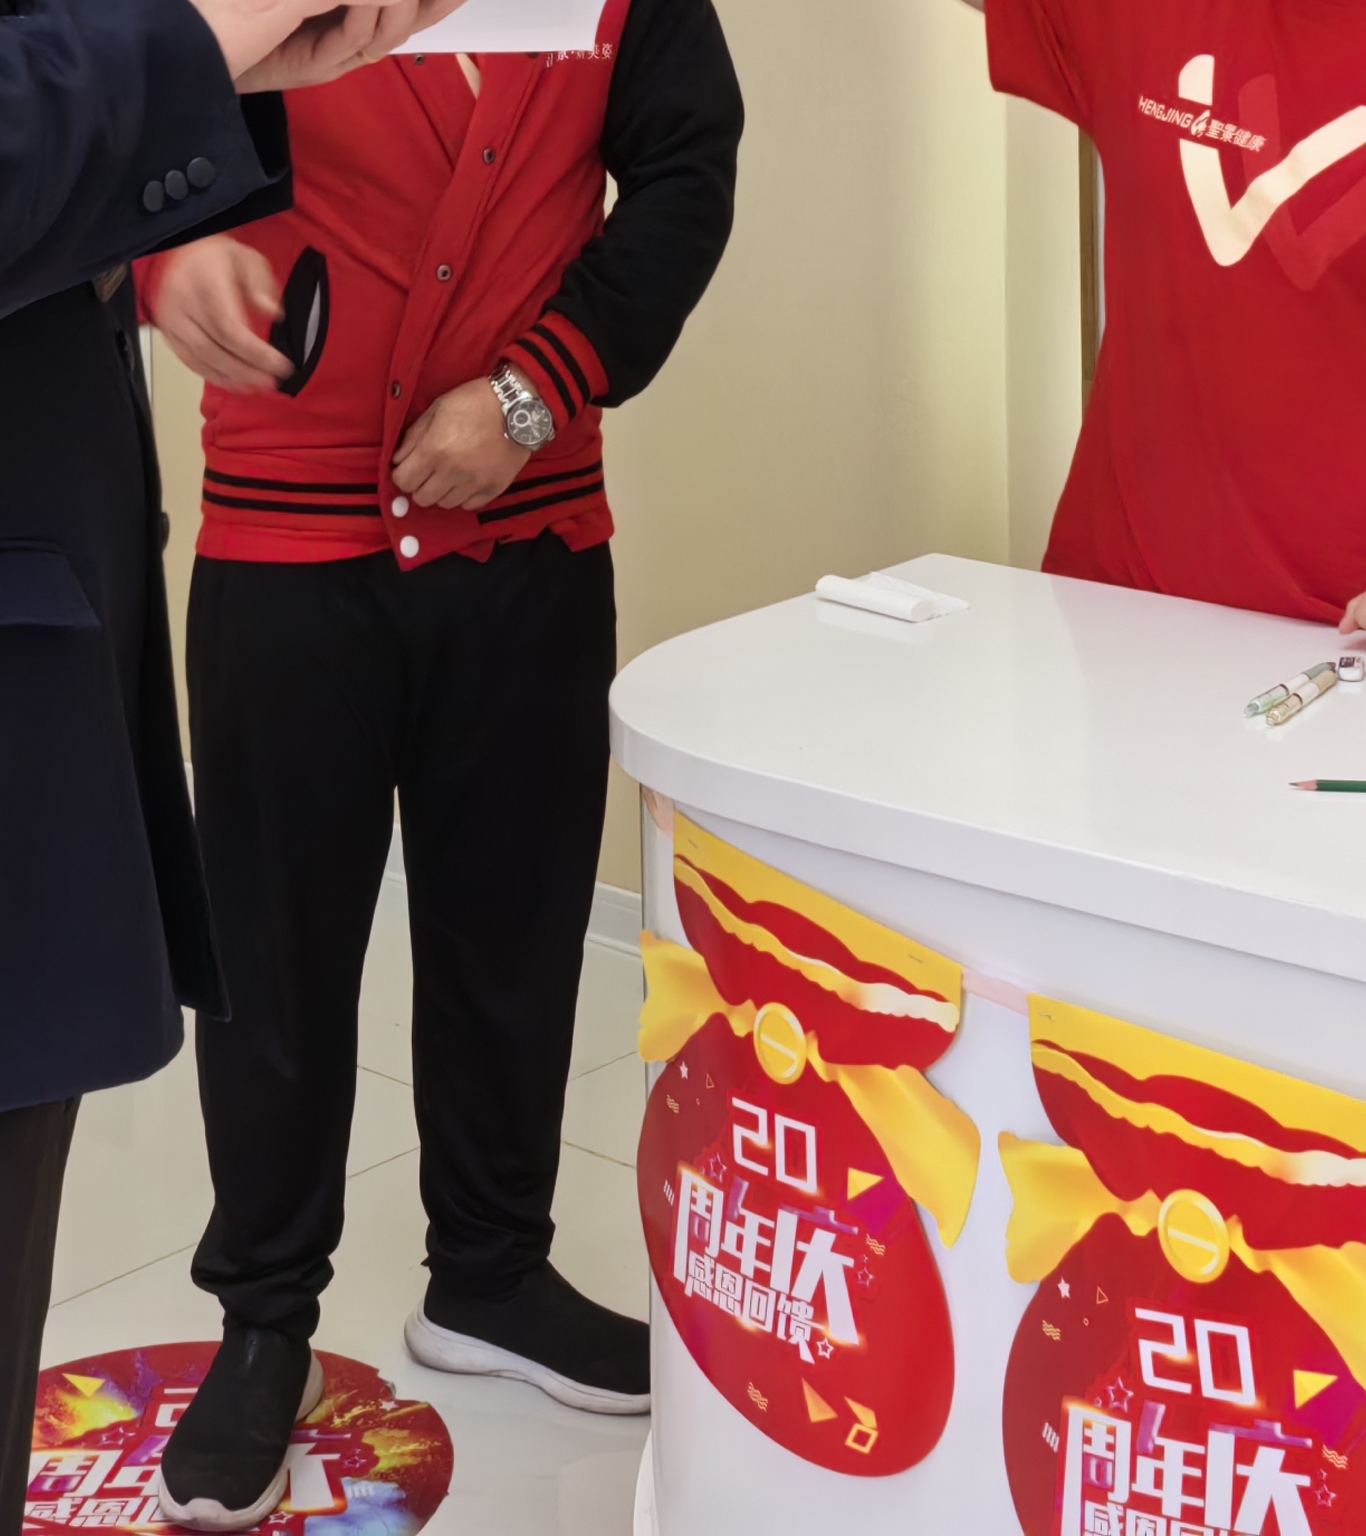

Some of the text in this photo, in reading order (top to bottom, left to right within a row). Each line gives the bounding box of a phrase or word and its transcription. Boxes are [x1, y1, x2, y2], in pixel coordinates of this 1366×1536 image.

[1206, 119, 1267, 153] 聖景健康
[731, 1096, 819, 1193] 20
[674, 1167, 861, 1345] 周年庆
[685, 1250, 826, 1364] 感恩回馈
[1134, 1306, 1256, 1409] 20
[1061, 1400, 1313, 1536] 周年庆
